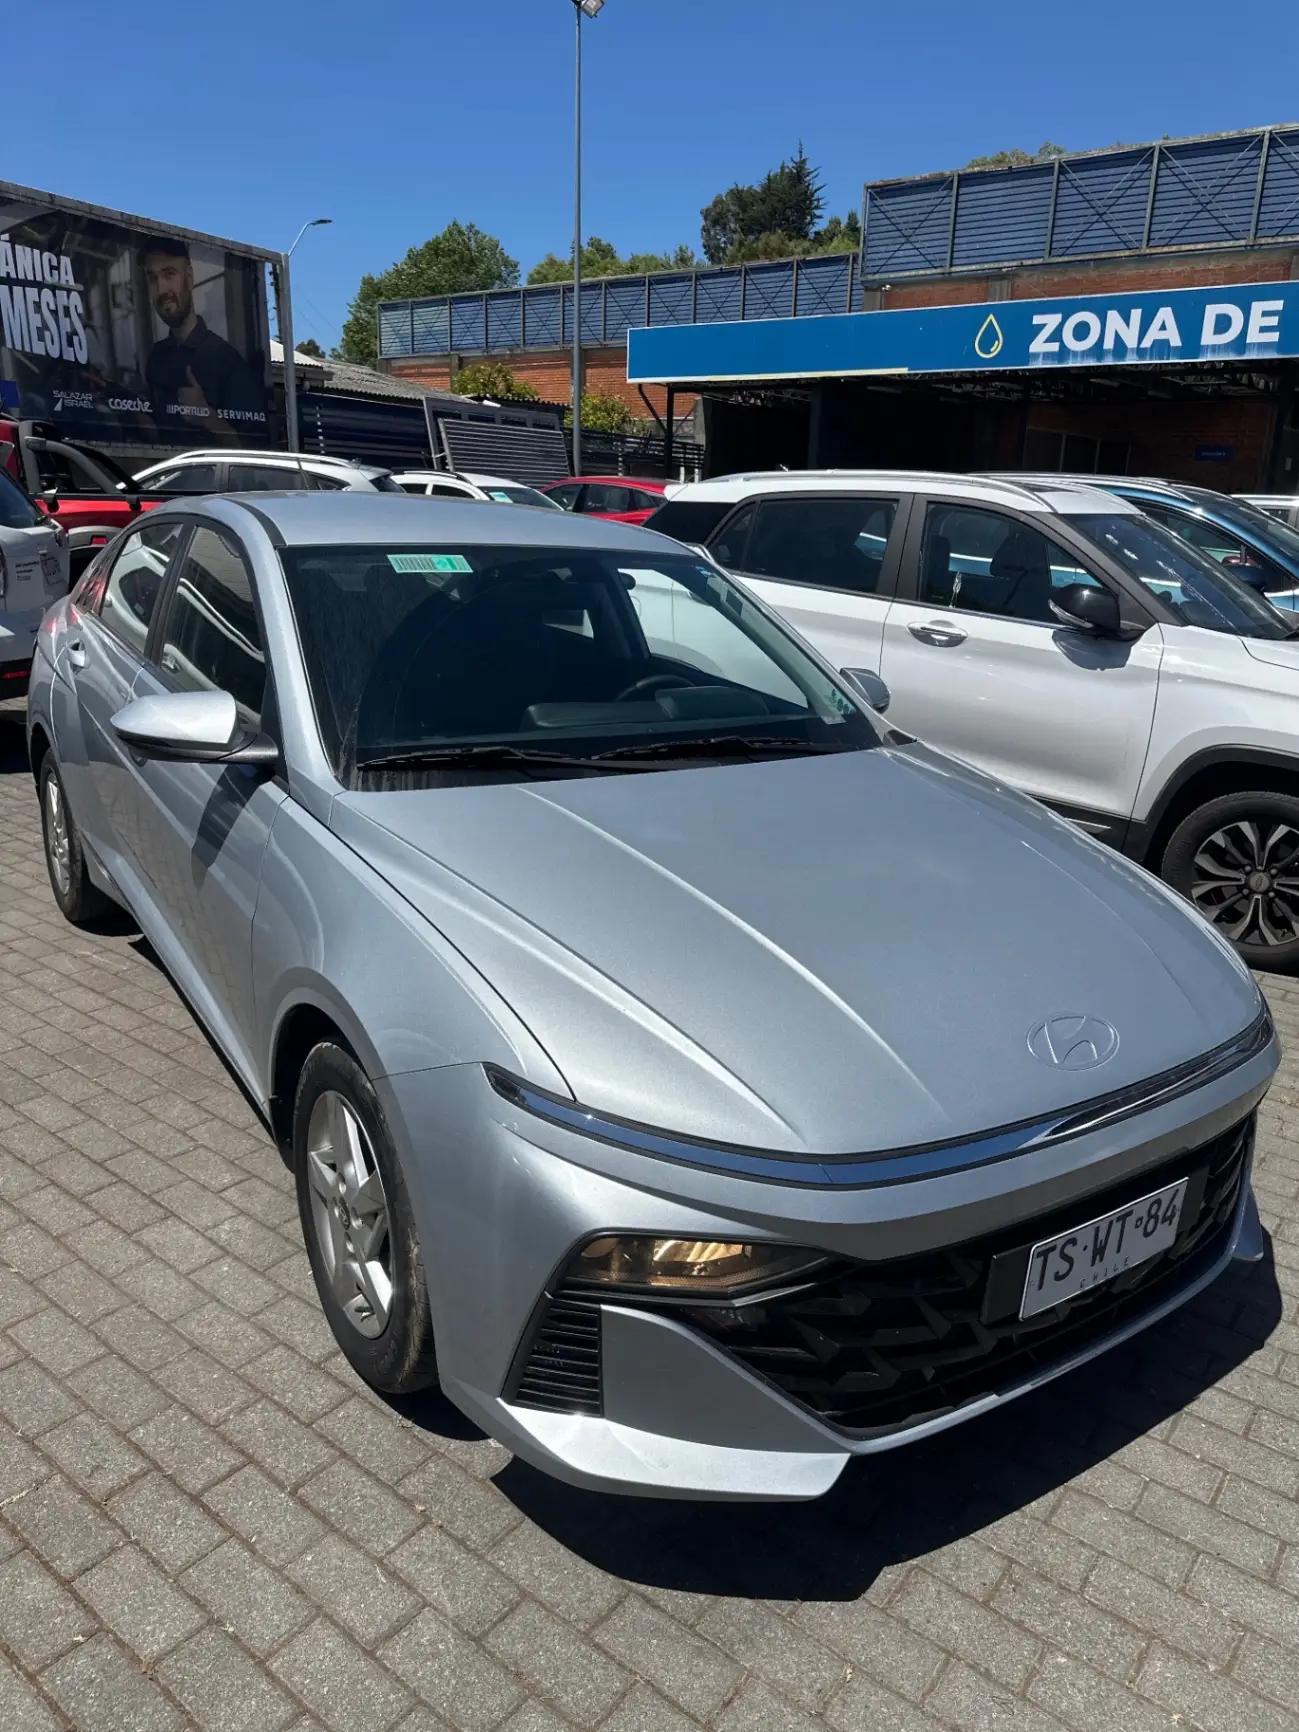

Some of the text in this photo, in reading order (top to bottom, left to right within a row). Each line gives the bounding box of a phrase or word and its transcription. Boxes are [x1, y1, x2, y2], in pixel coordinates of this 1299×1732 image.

[0, 285, 88, 364] MESES
[1029, 300, 1284, 353] ZONA DE
[53, 390, 94, 401] SALAZAR
[64, 399, 95, 409] ISRAEL
[217, 409, 267, 423] SERVIMAQ
